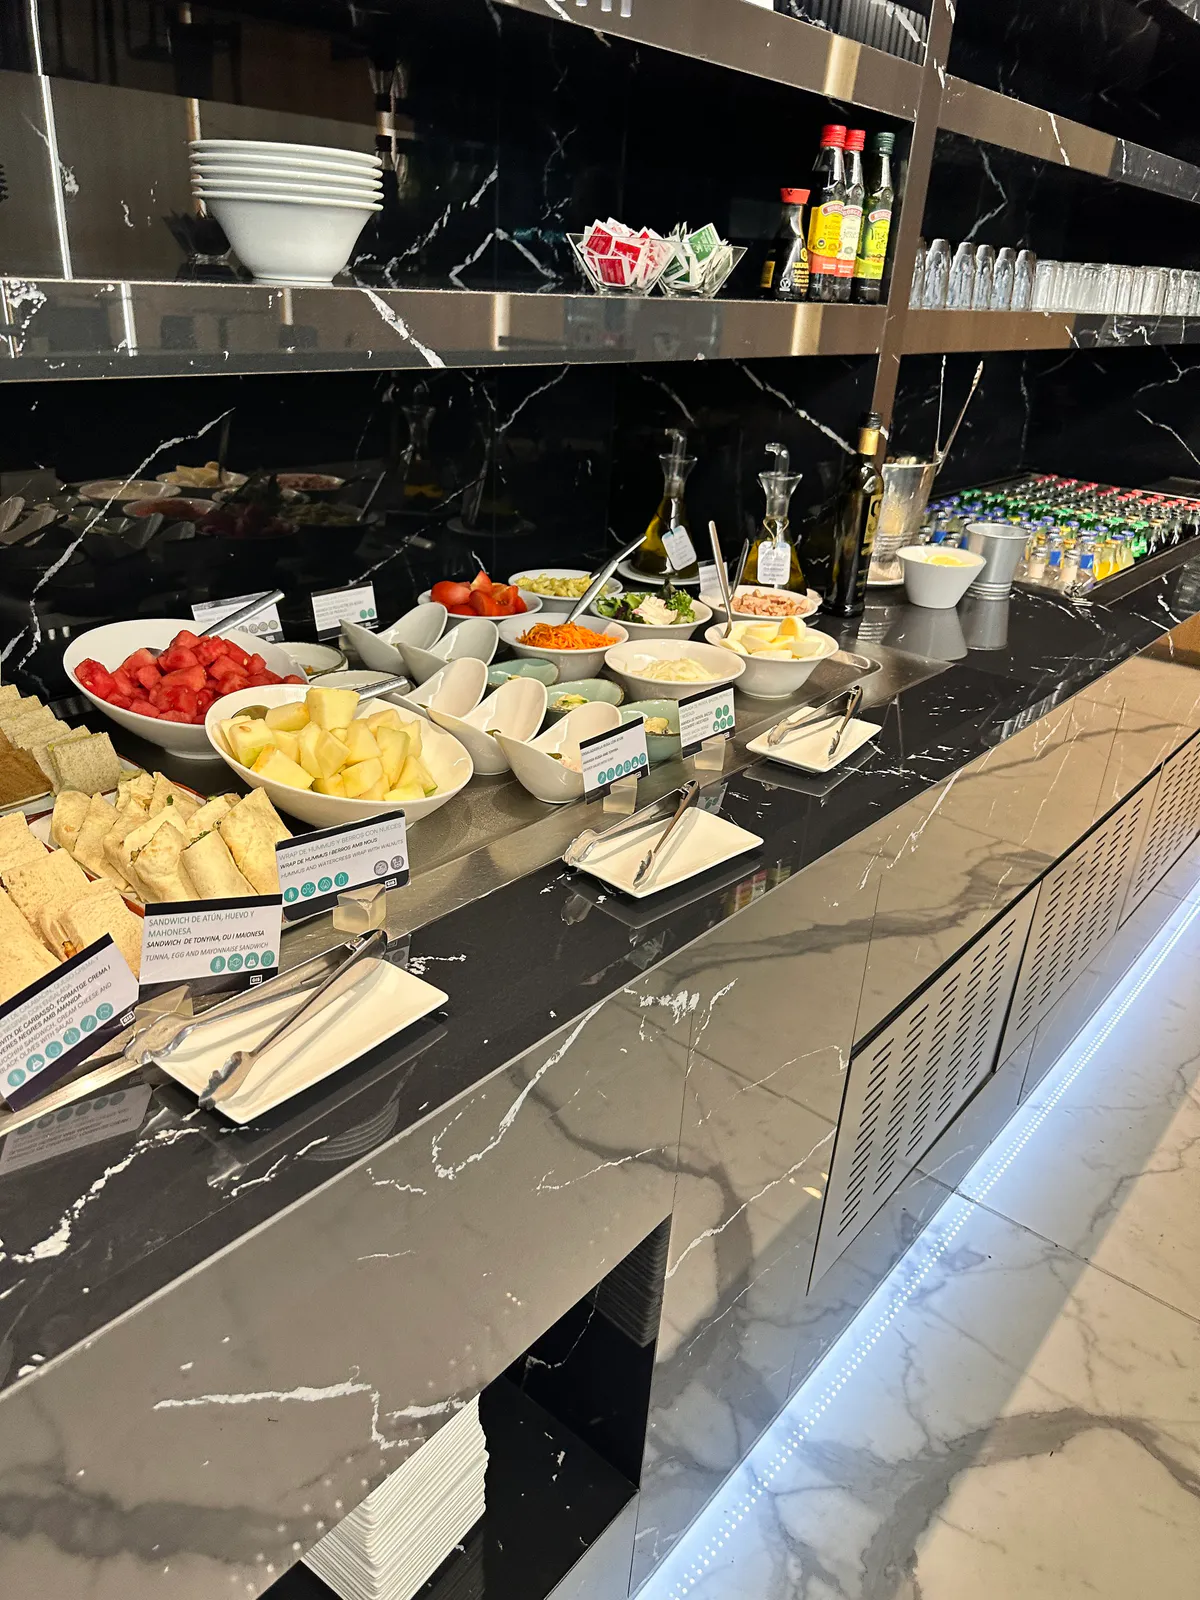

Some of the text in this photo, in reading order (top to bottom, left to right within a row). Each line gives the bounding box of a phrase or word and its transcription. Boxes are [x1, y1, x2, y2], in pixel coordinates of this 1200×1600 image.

[279, 850, 298, 860] WRAP
[308, 842, 336, 853] HUMMUS
[342, 833, 365, 845] BERROS
[365, 828, 379, 838] CON
[379, 822, 402, 834] NUECES
[279, 860, 296, 870] WRAP
[331, 845, 351, 856] BERROS
[364, 837, 378, 846] NOUS
[306, 864, 318, 873] AND
[318, 854, 352, 869] WATERCRESS
[352, 849, 367, 858] WRAP
[380, 839, 404, 850] WALNUTS
[148, 927, 192, 938] MAHONESA
[149, 916, 190, 927] SANDWICH
[191, 914, 201, 924] DE
[202, 912, 224, 923] ATÚN,
[225, 911, 248, 920] HUEVO
[145, 954, 170, 962] TUNNA,
[200, 945, 239, 956] MAYONNAISE
[239, 942, 268, 952] SANDWICH
[146, 940, 181, 949] SANDWICH
[193, 935, 220, 944] TONYINA,
[235, 930, 265, 939] MAIONESA
[14, 1027, 23, 1036] DE
[56, 981, 87, 1006] FORMATGE
[88, 967, 109, 987] CREMA
[18, 1023, 43, 1041] NEGRES
[43, 1013, 56, 1024] AMB
[56, 994, 83, 1016] AMANIDA
[57, 1005, 77, 1024] CREAM
[77, 992, 100, 1010] CHEESE
[99, 981, 112, 995] AND
[20, 1042, 40, 1059] OLIVES
[40, 1028, 56, 1044] WITH
[56, 1017, 74, 1033] SALAD
